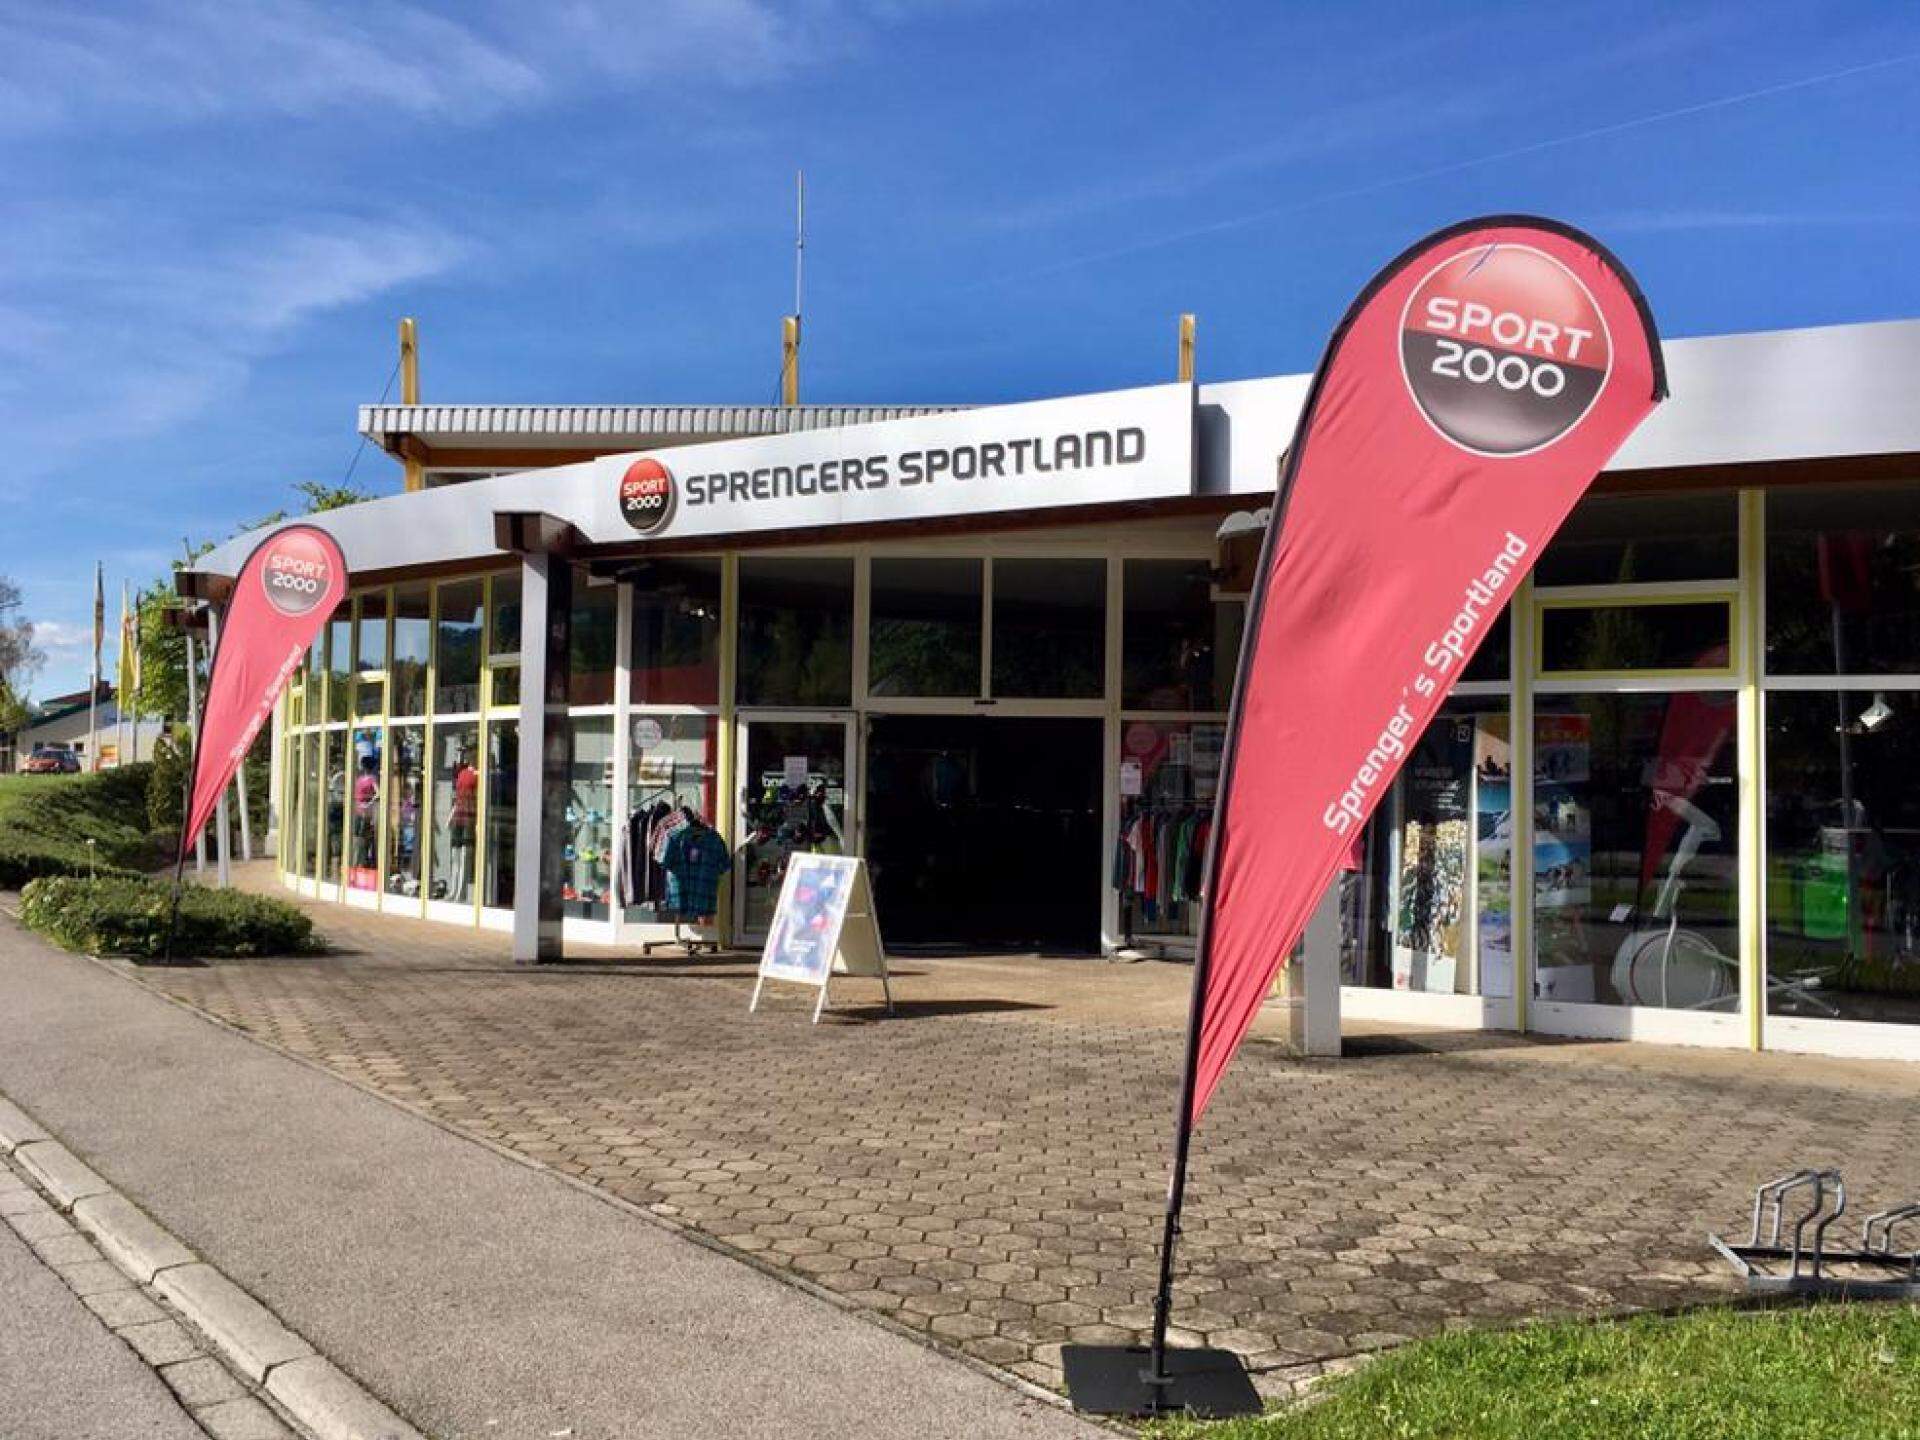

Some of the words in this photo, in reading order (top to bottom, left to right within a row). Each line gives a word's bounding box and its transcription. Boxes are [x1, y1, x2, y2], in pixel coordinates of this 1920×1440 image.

[1426, 297, 1592, 360] SPORT
[1431, 339, 1565, 397] 2000
[685, 455, 889, 505] SPRENGERS
[899, 427, 1146, 485] SPORTLAND
[623, 477, 666, 497] SPORT
[627, 493, 662, 511] 2000
[272, 555, 326, 580] SPORT
[272, 571, 317, 593] 2000
[1424, 530, 1528, 673] Sportland
